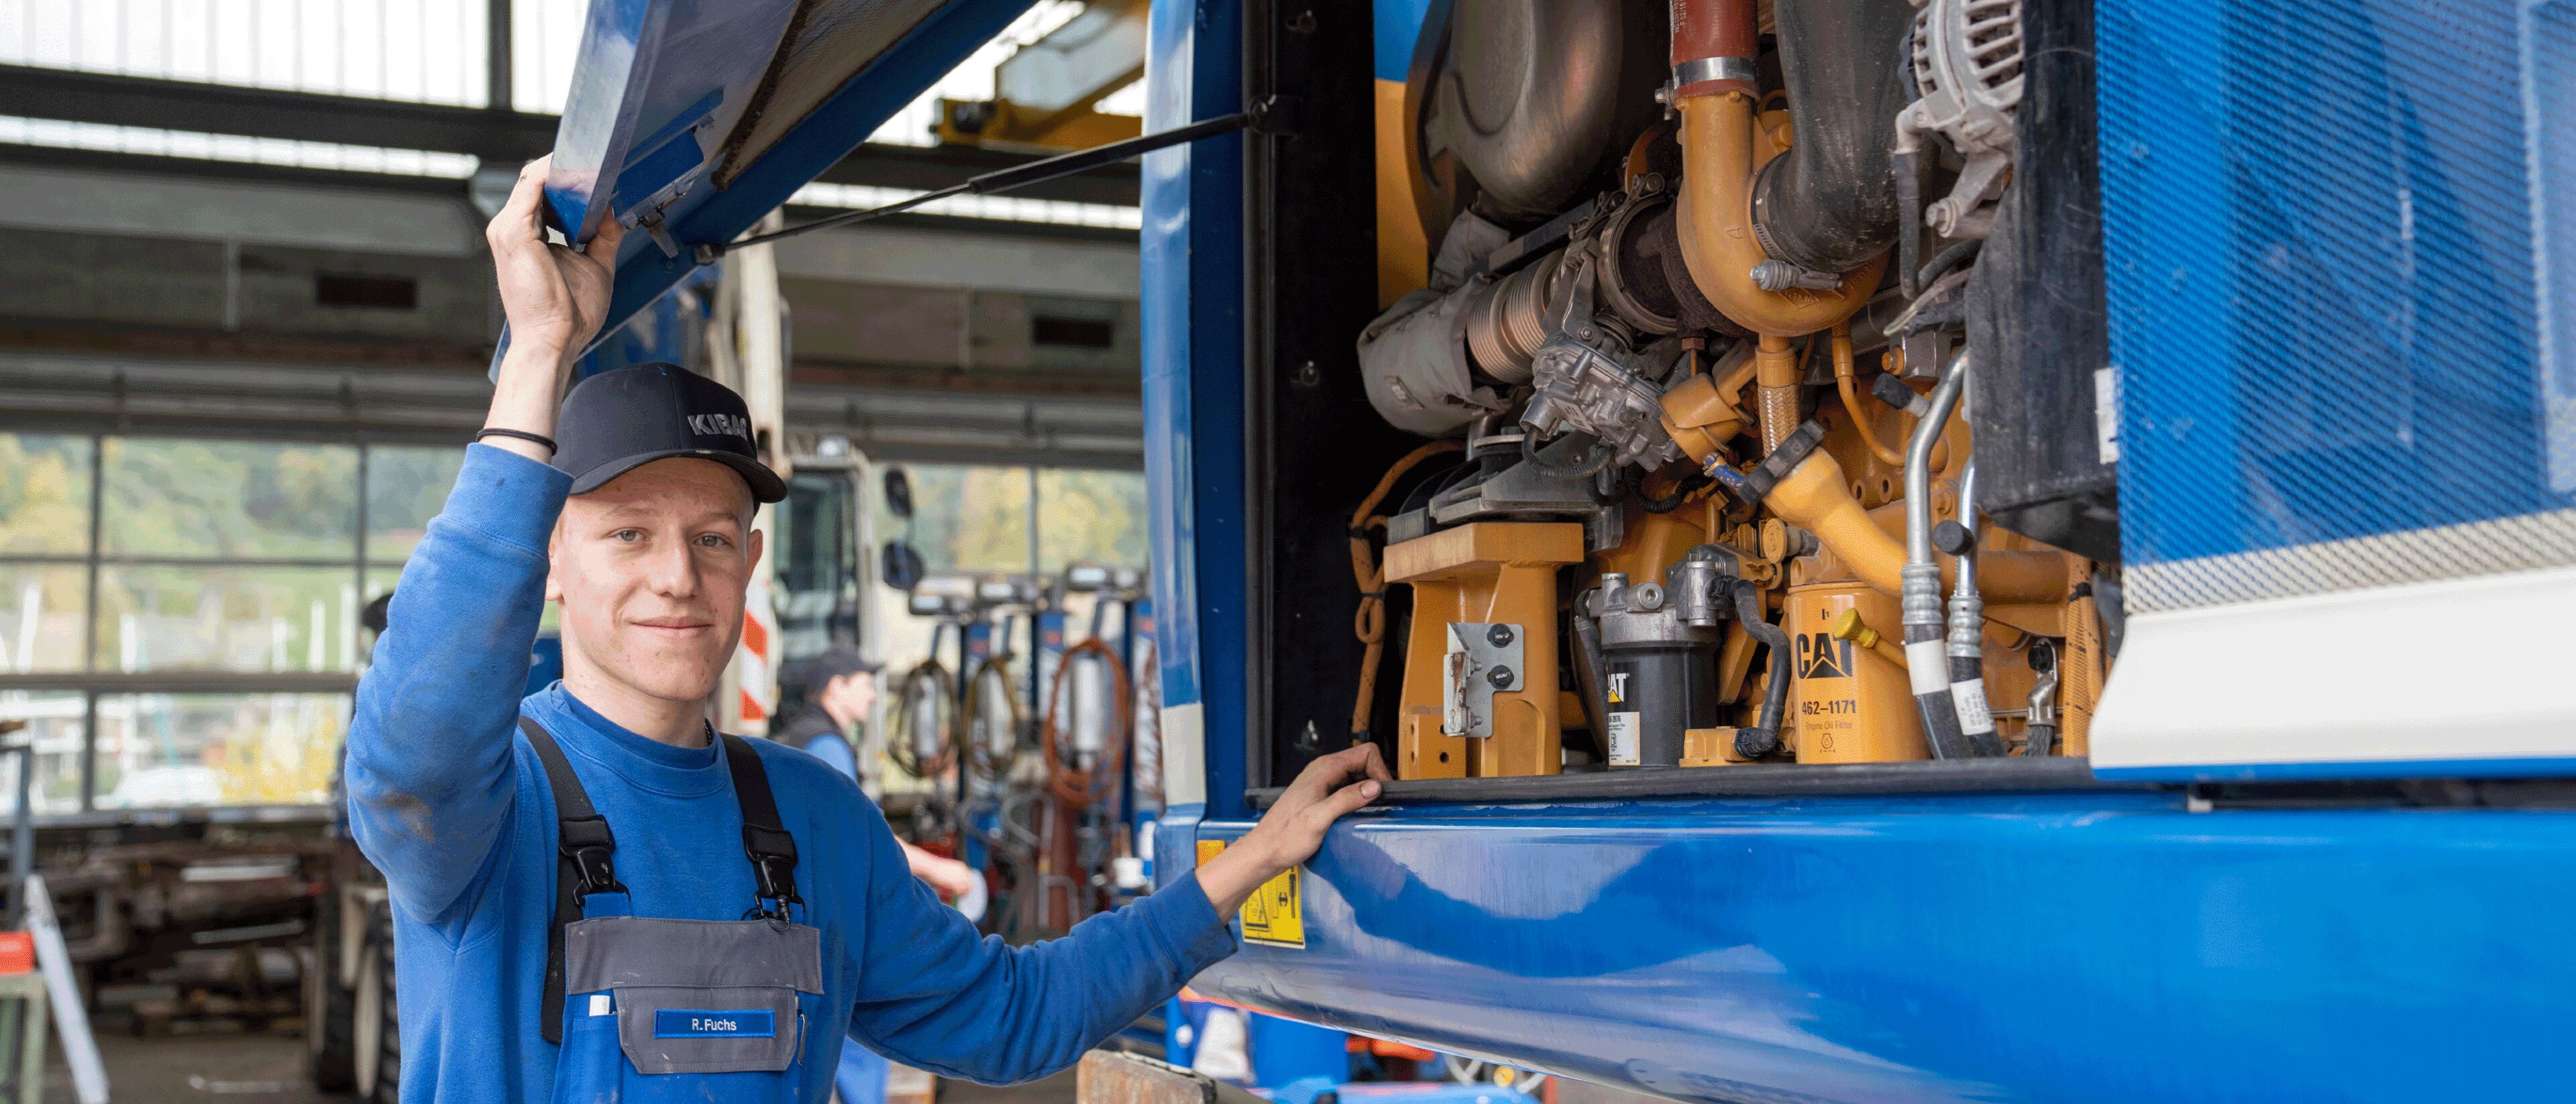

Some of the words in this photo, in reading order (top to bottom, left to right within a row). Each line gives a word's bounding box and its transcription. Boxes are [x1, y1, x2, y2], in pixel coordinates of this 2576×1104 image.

[1796, 633, 1853, 679] CAT
[1608, 673, 1627, 702] AT
[1802, 700, 1856, 715] 462-1171
